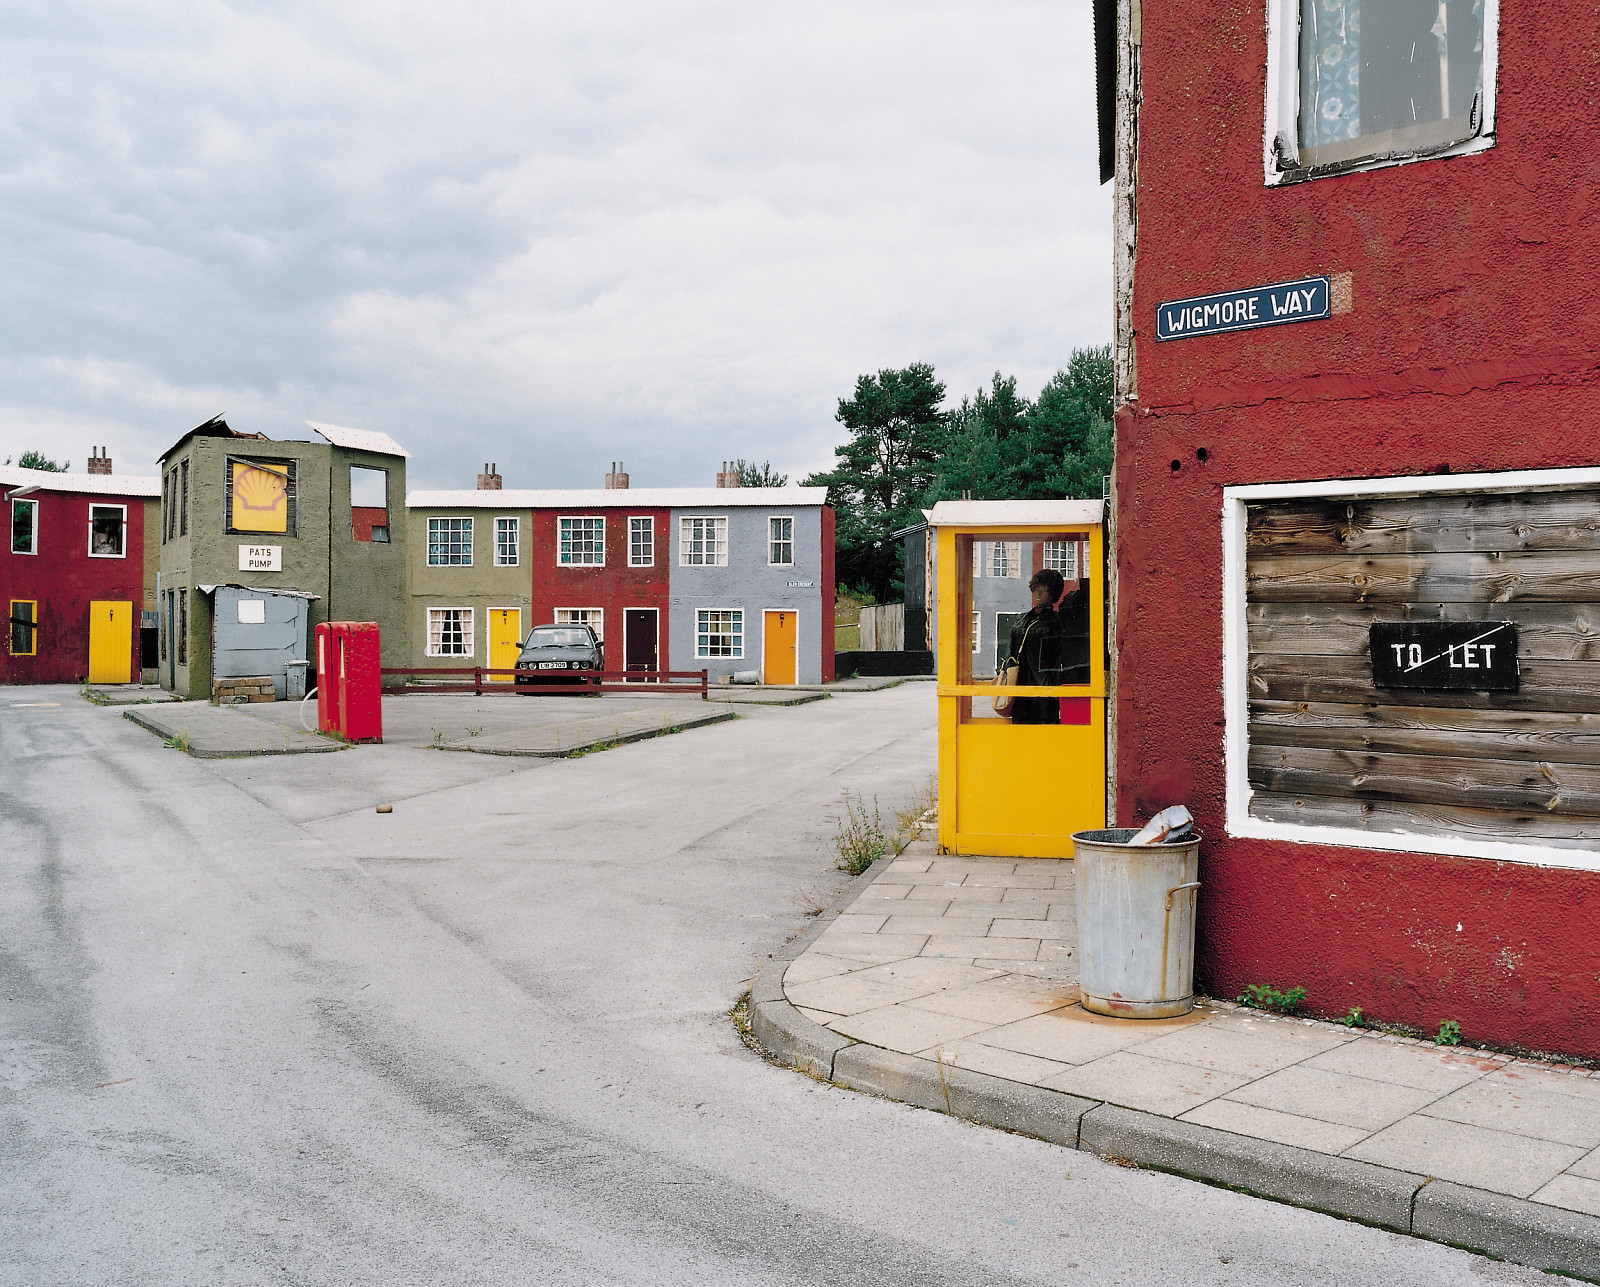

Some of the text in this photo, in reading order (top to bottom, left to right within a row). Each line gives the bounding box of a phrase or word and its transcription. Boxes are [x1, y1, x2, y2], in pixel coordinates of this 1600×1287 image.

[1167, 287, 1318, 332] WIGMORE WAY
[249, 548, 272, 557] PATS
[249, 559, 272, 568] PUMP
[1390, 643, 1496, 669] TO LET
